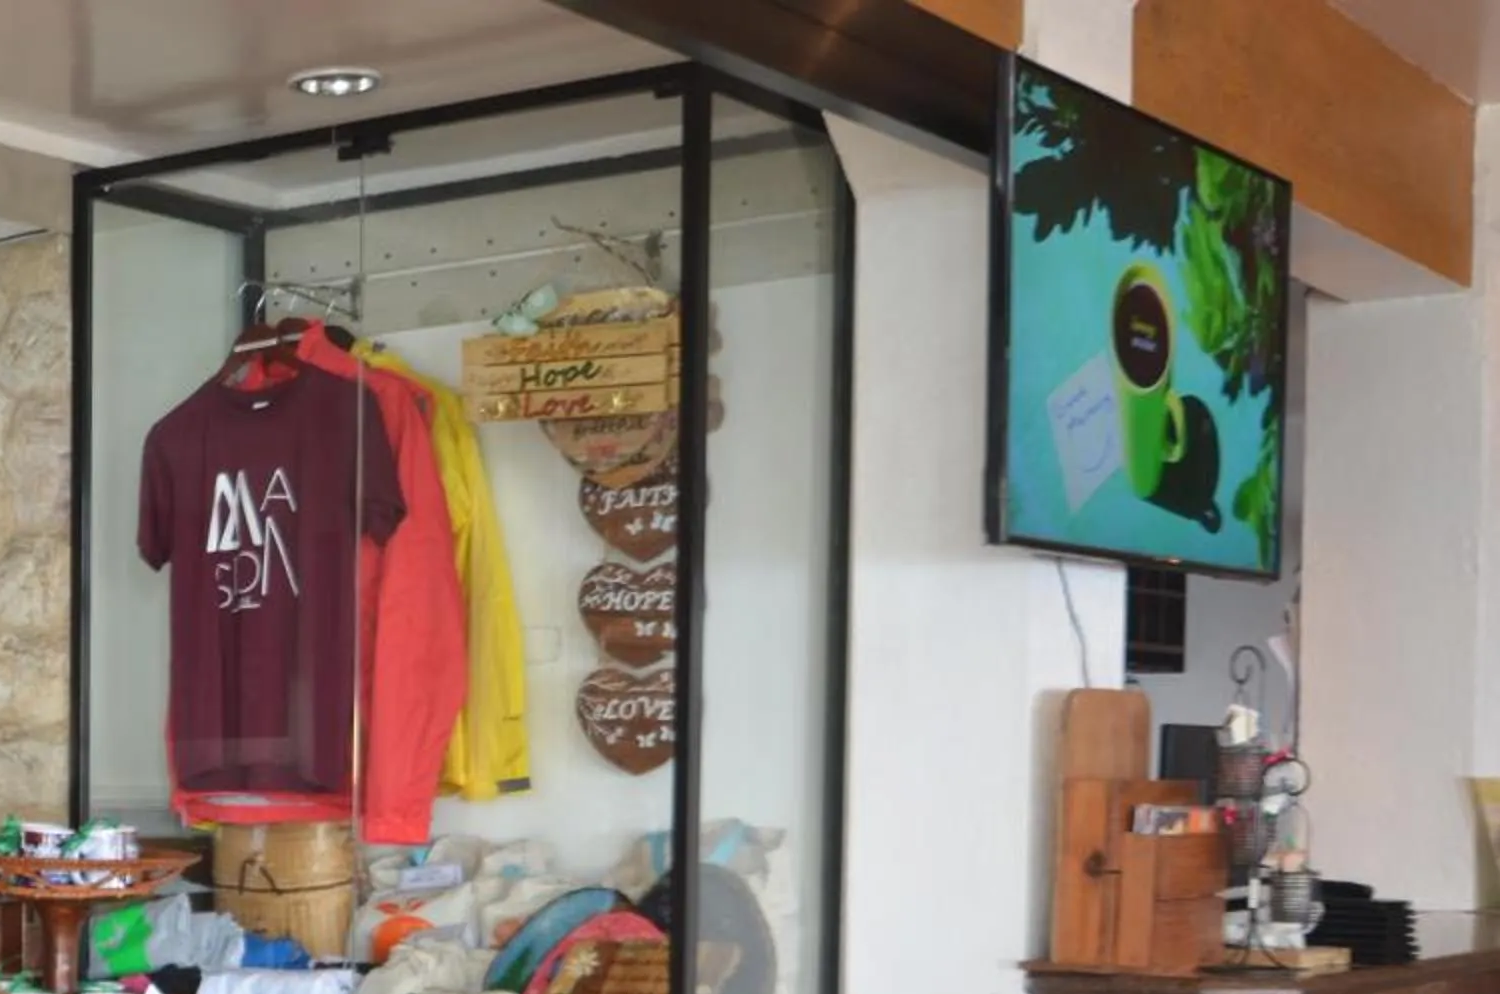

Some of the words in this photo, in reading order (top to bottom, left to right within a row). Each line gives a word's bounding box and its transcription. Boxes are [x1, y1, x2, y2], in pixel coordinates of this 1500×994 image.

[519, 361, 602, 389] Hope
[519, 390, 598, 419] Love
[600, 590, 675, 611] HOPE
[603, 697, 676, 720] LOVE
